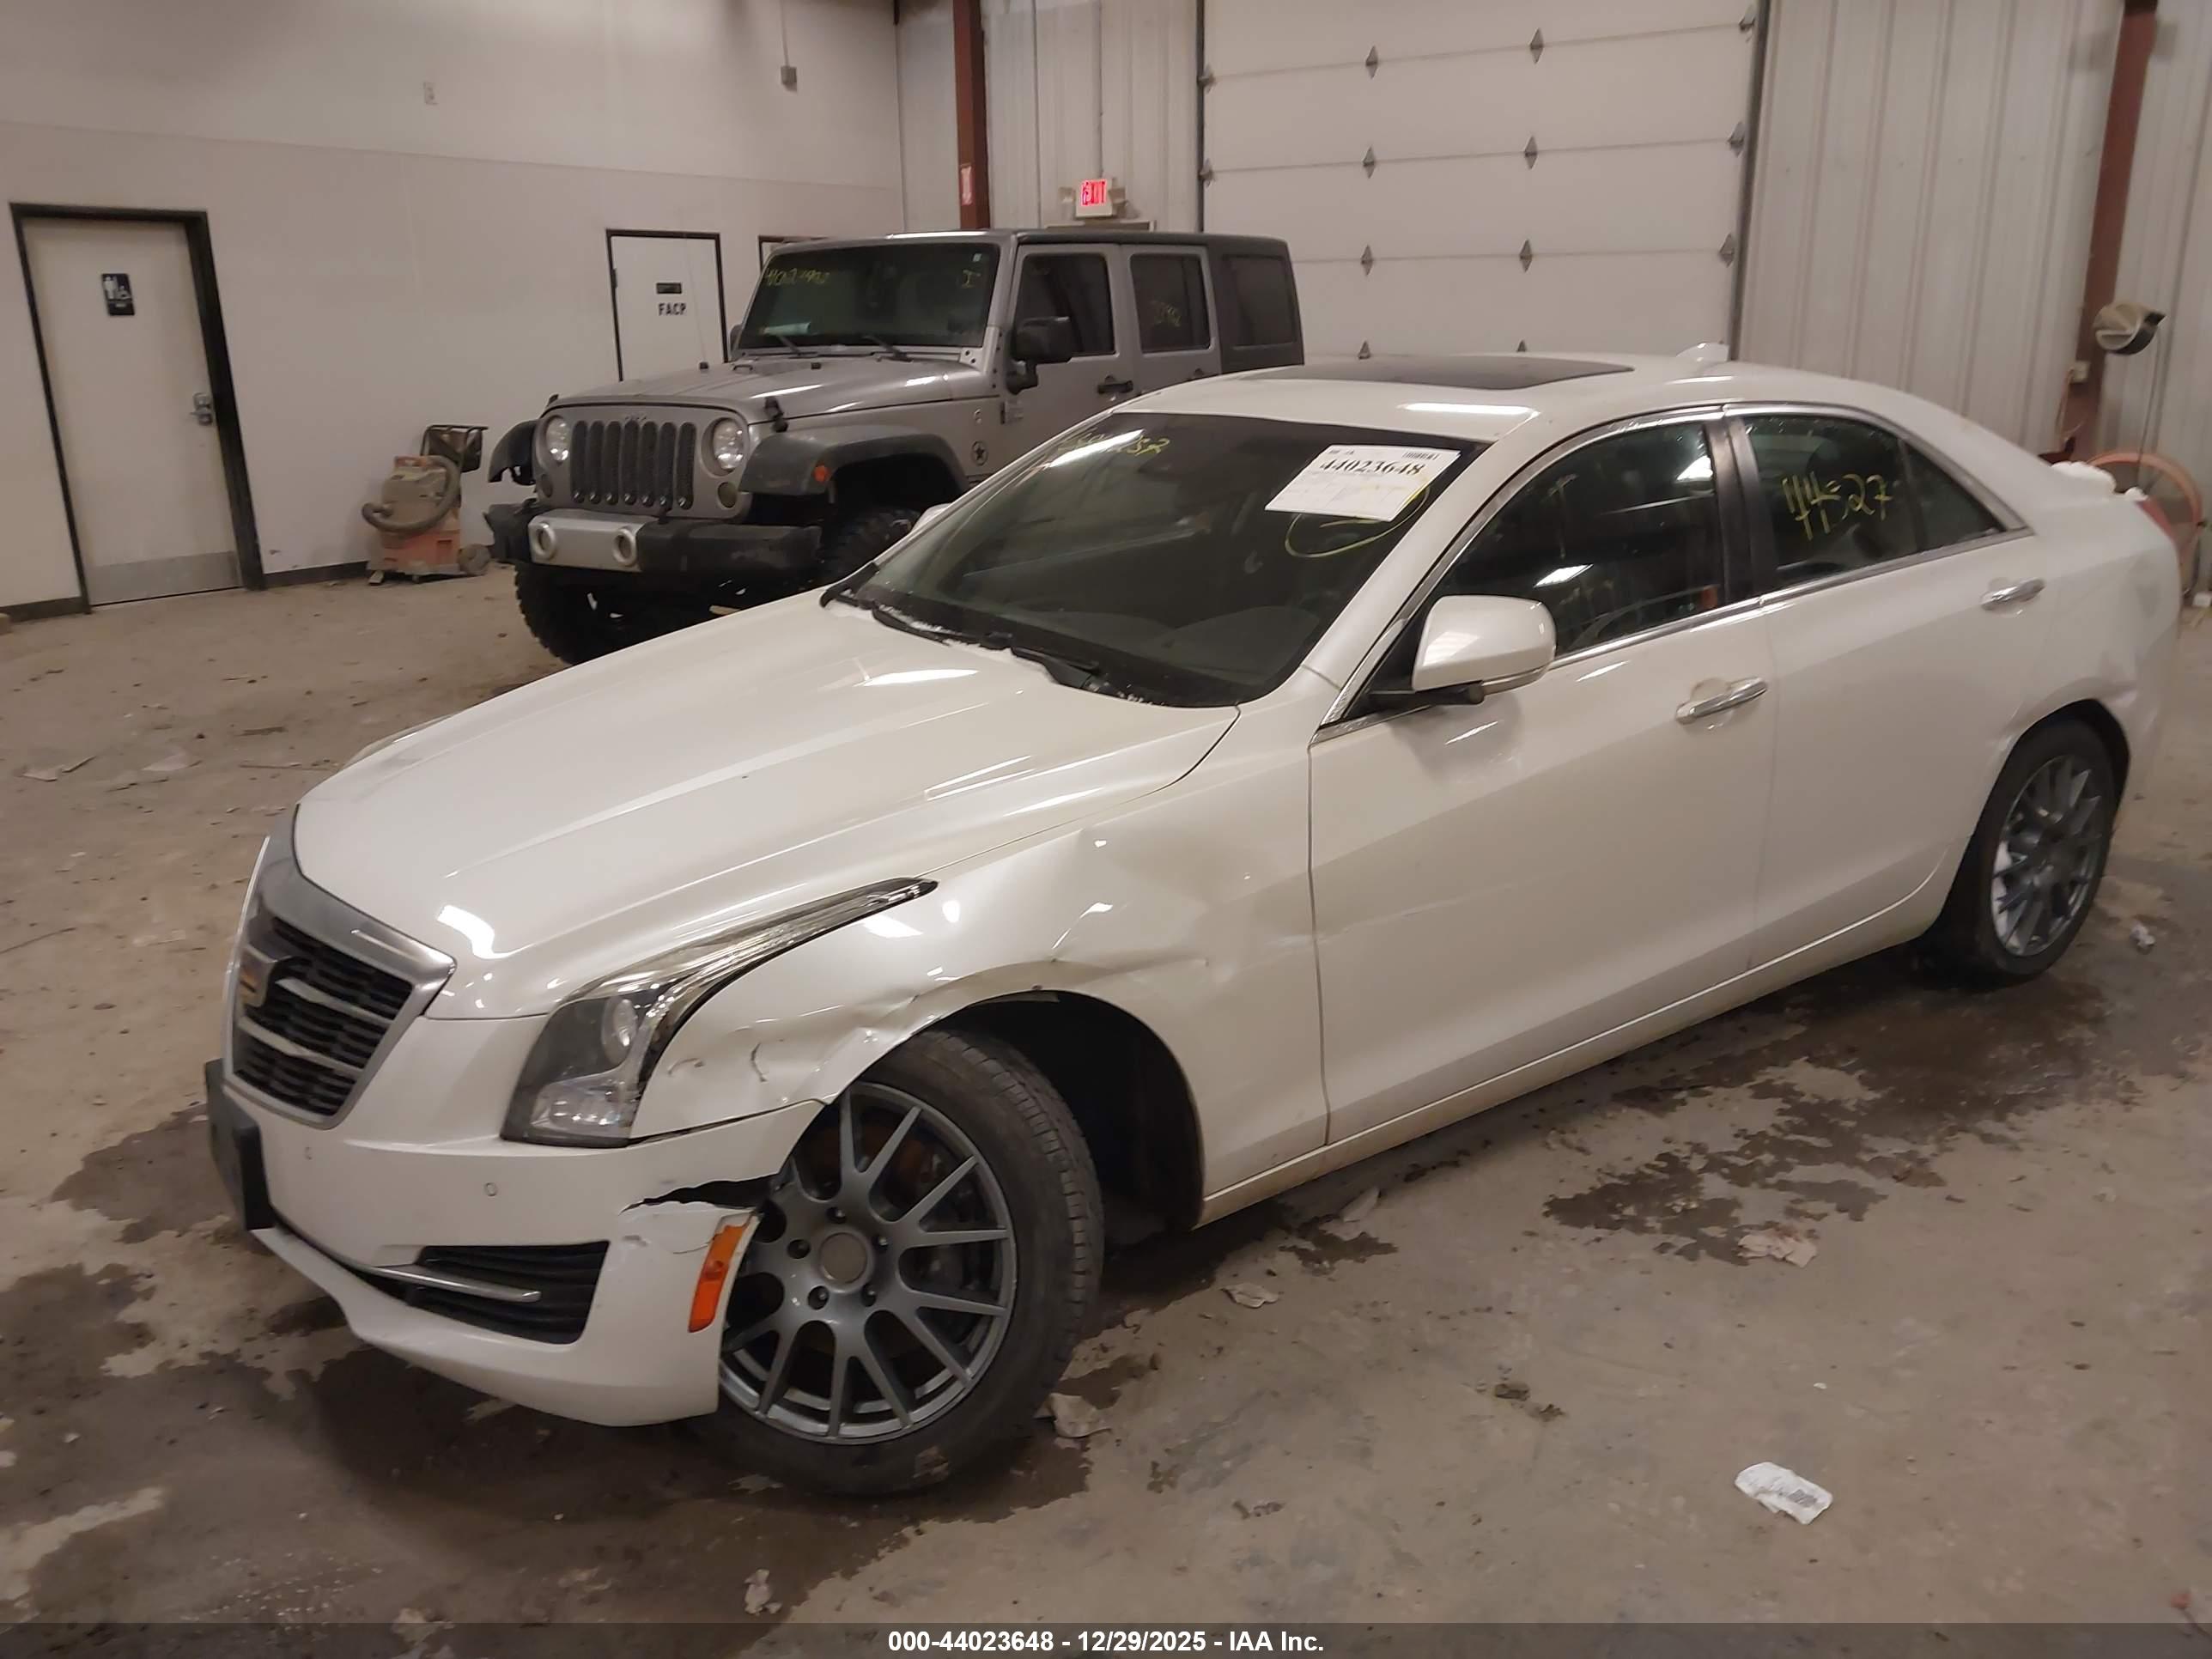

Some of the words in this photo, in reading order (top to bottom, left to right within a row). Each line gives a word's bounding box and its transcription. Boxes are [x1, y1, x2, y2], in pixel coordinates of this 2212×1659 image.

[1081, 179, 1107, 206] EXIT
[659, 302, 687, 316] FACP
[1319, 459, 1426, 476] 44023648
